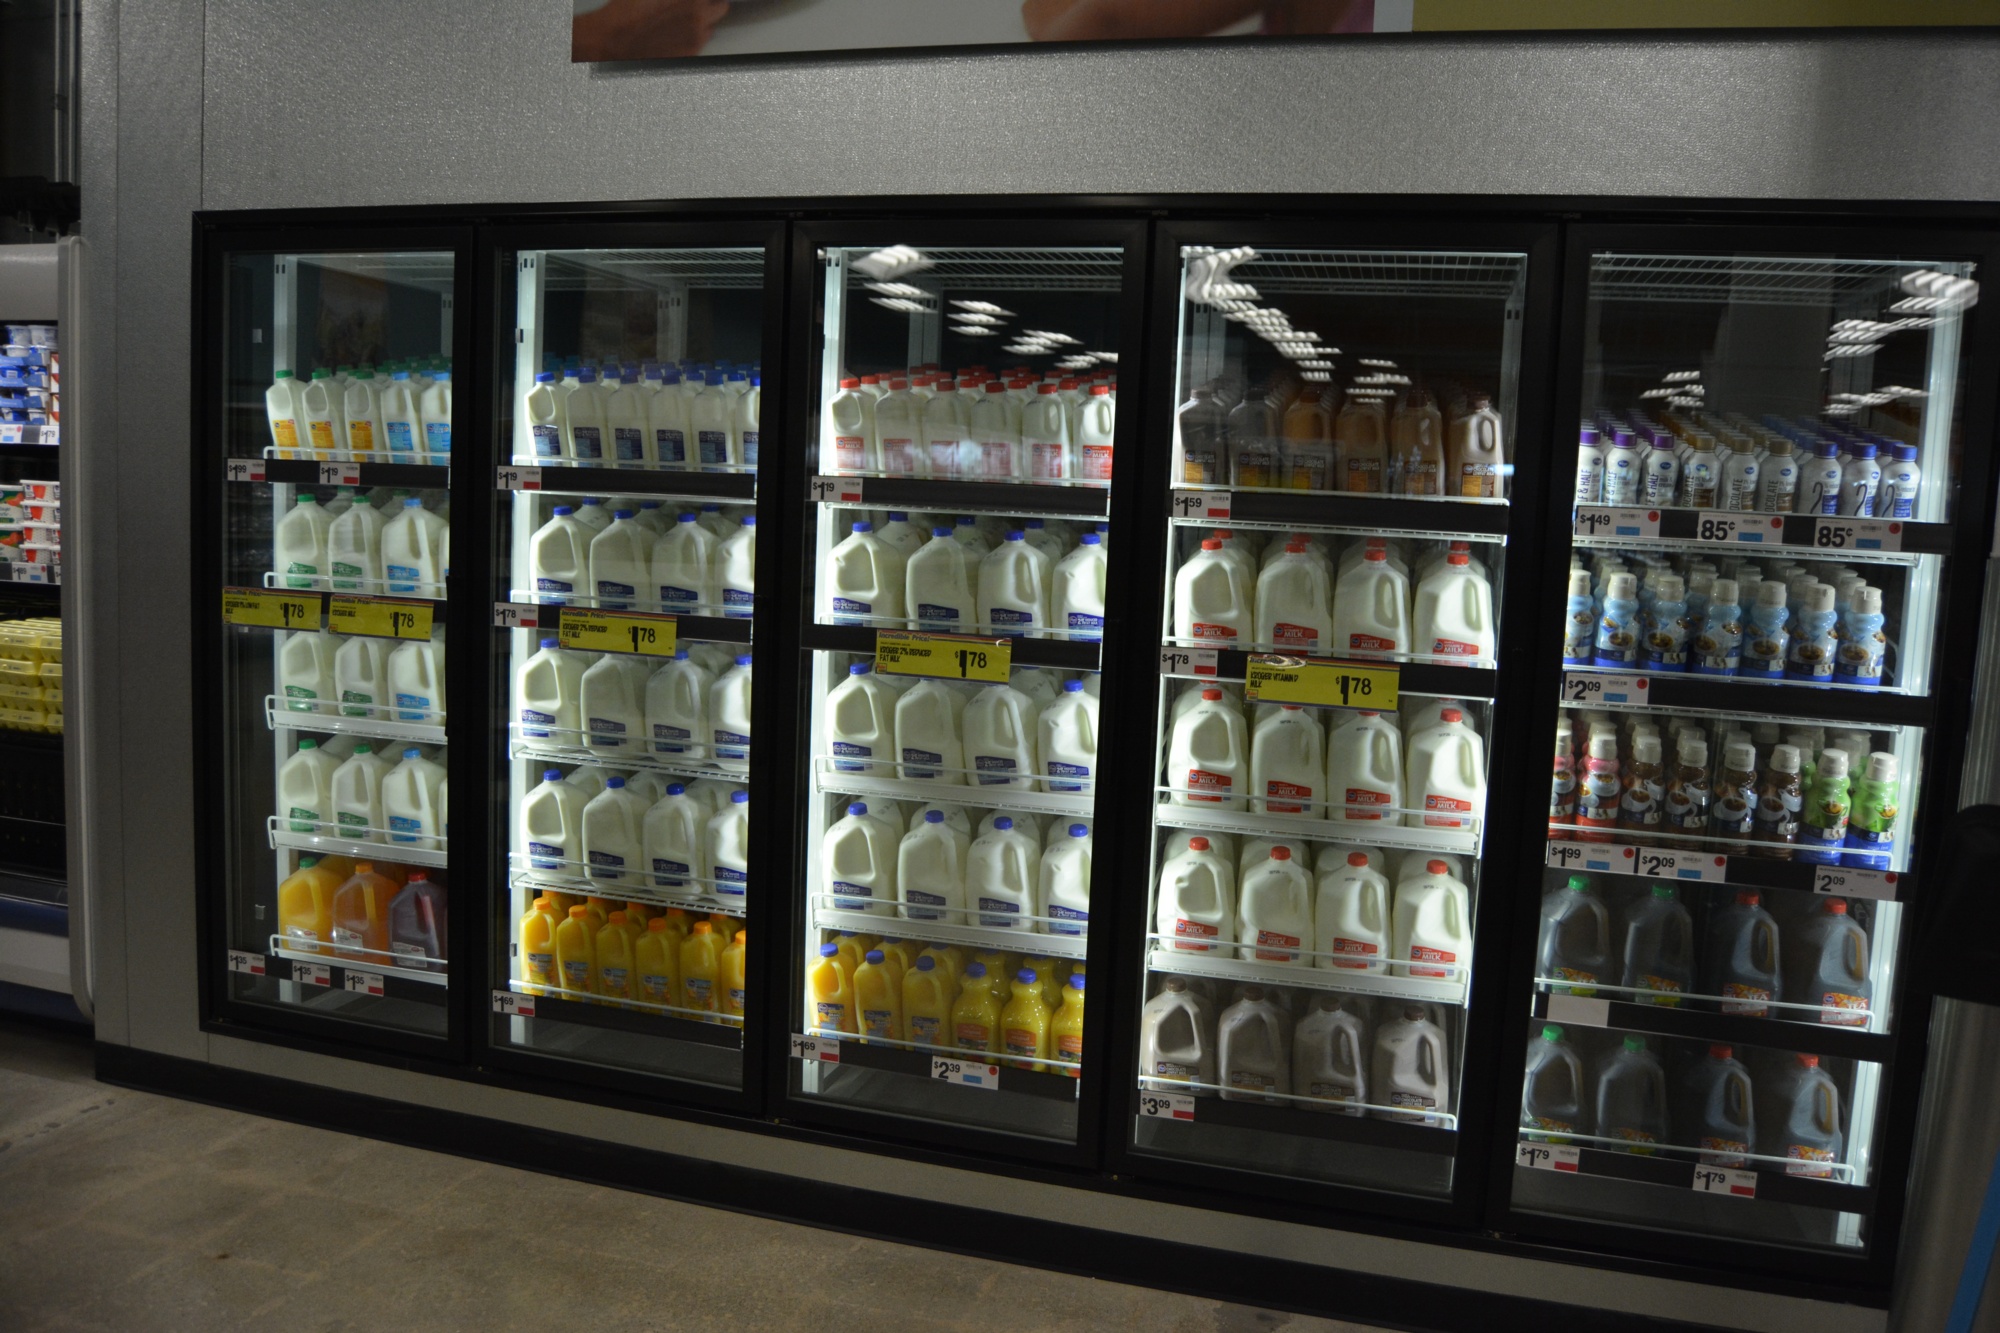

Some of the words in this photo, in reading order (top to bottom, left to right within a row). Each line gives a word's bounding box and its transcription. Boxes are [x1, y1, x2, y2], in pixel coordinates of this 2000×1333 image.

[1579, 469, 1592, 486] HALF
[1646, 473, 1659, 489] HALF
[562, 610, 588, 618] Incredible
[562, 630, 571, 638] FAT
[879, 632, 910, 640] Incredible
[912, 634, 930, 642] Price!
[880, 646, 898, 654] KROGER
[880, 654, 889, 662] FAT
[1250, 672, 1272, 680] KROGER
[1273, 673, 1294, 682] VITAMIN
[1250, 680, 1262, 688] MILK
